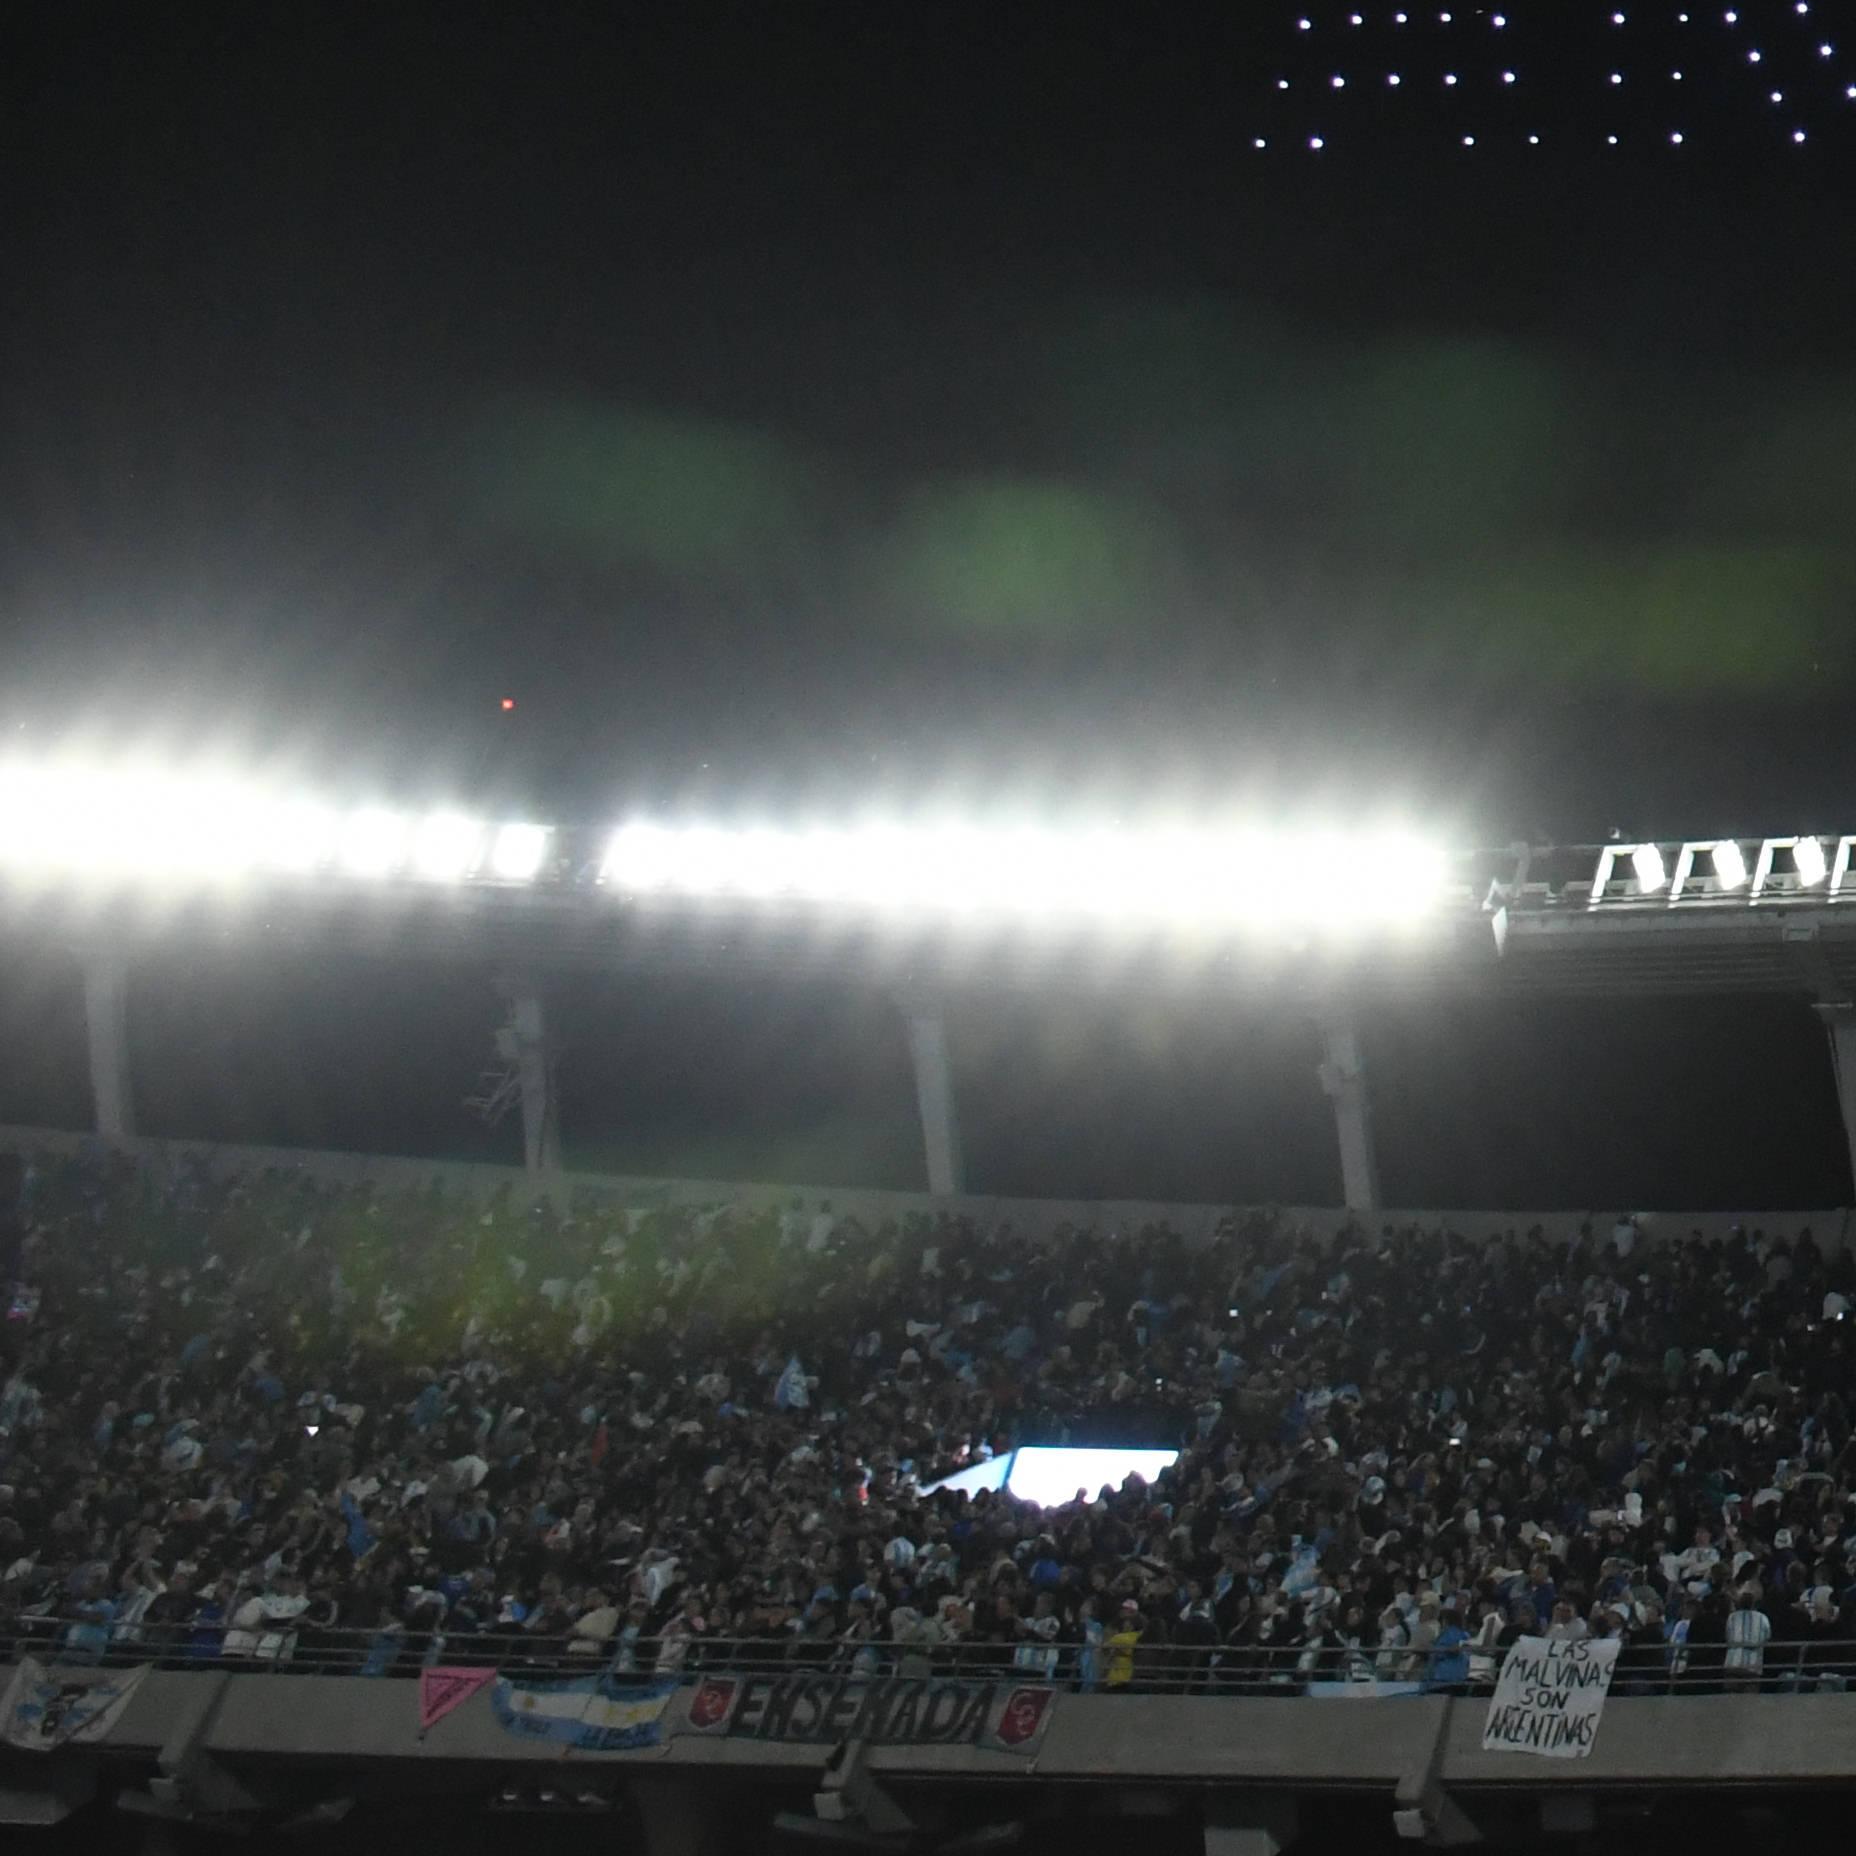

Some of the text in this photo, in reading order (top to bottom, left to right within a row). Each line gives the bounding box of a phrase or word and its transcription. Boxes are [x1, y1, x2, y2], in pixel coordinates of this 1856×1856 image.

[1547, 1640, 1589, 1662] LAS
[1520, 1687, 1570, 1709] SON
[727, 1678, 998, 1742] ENSENADA
